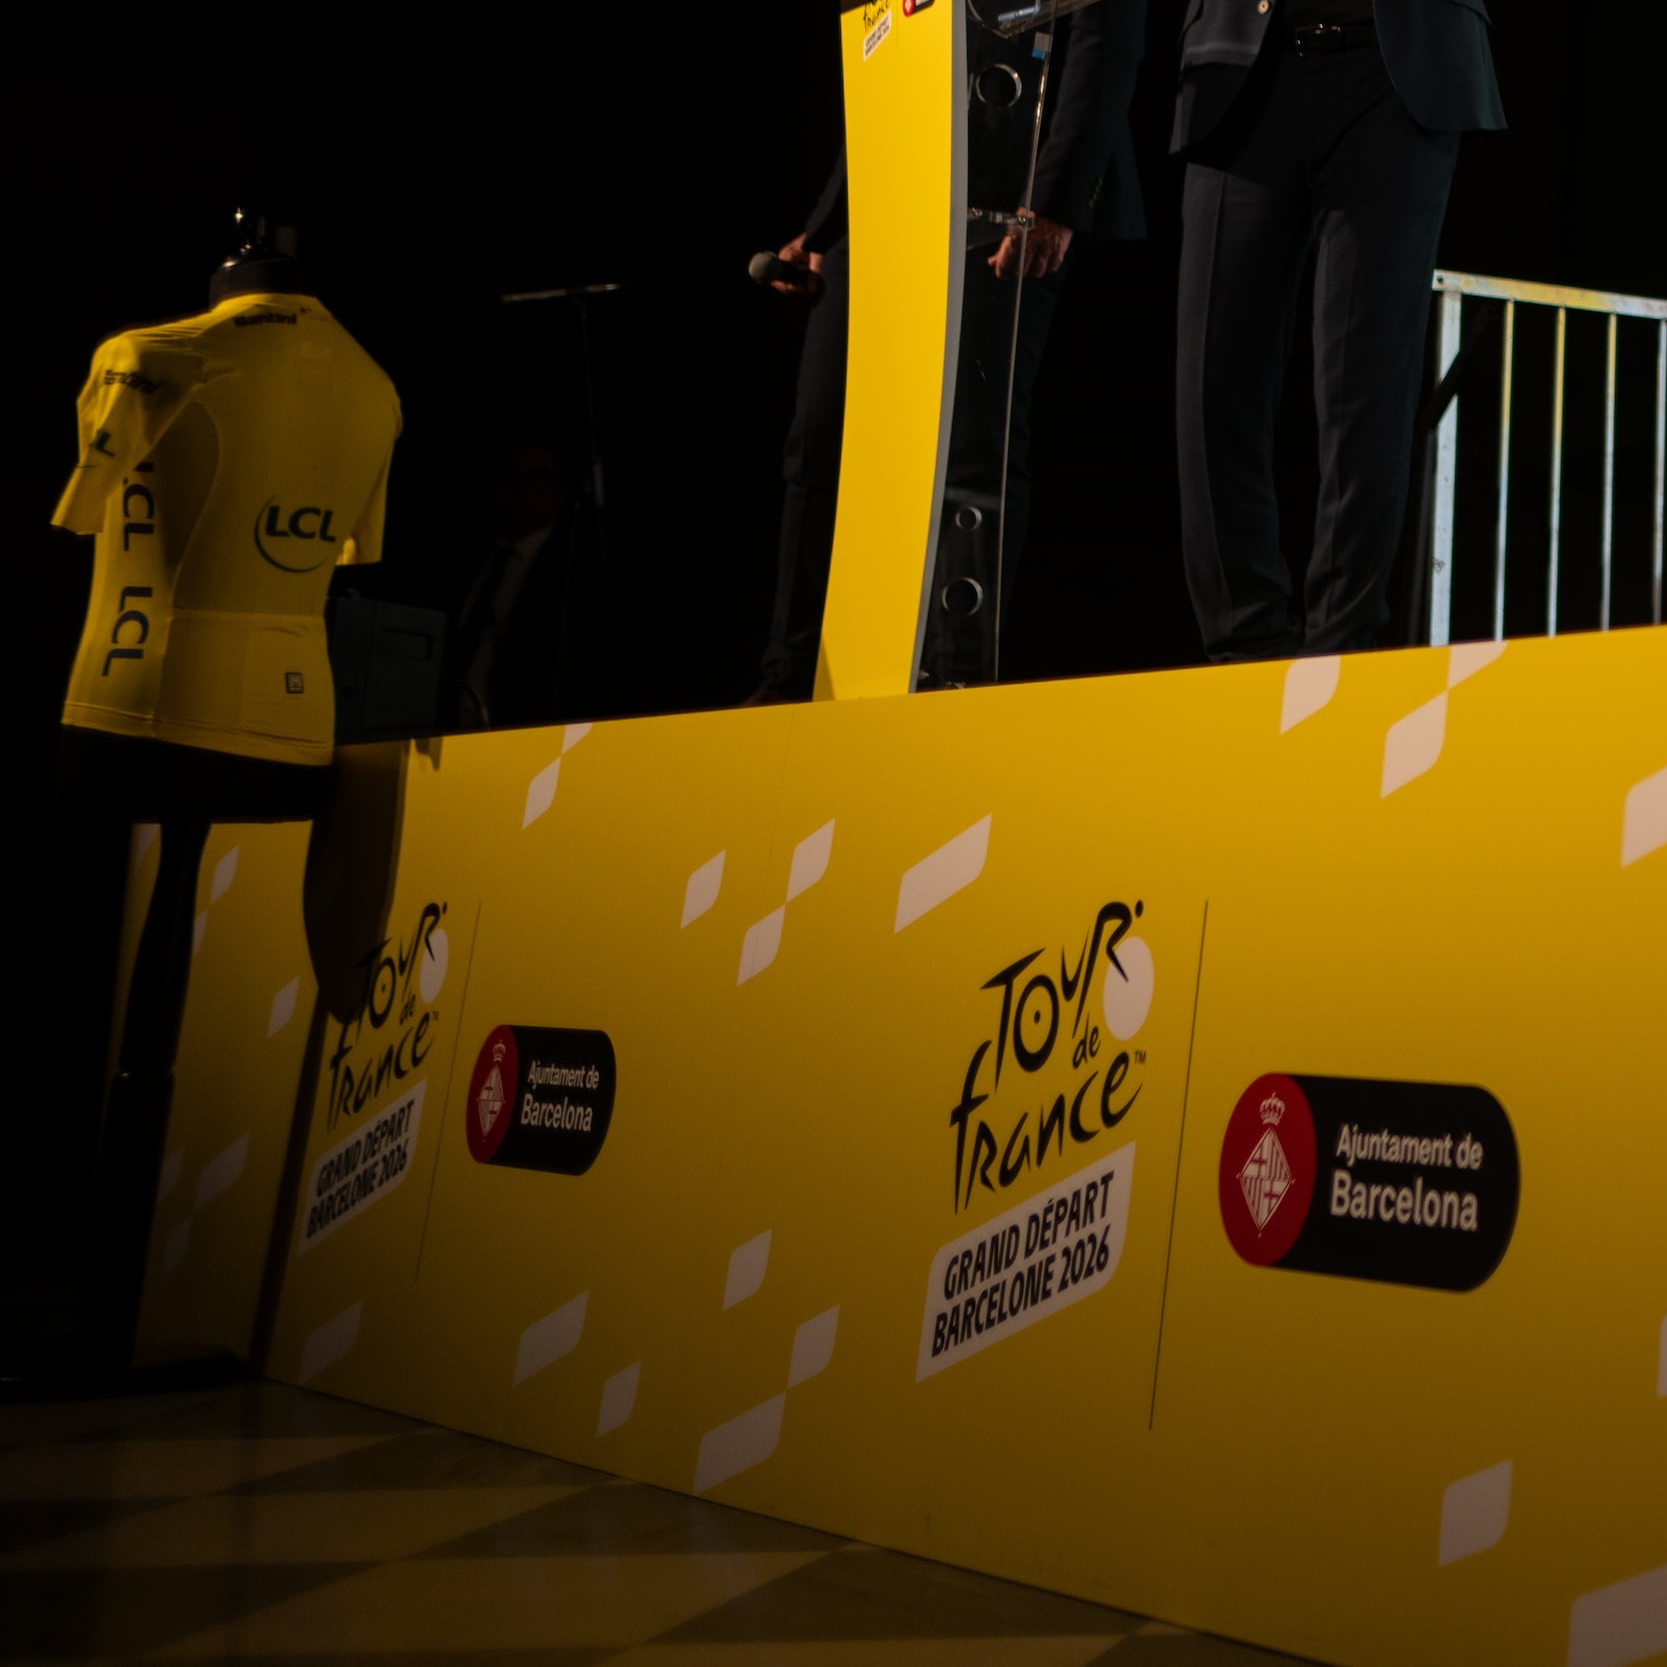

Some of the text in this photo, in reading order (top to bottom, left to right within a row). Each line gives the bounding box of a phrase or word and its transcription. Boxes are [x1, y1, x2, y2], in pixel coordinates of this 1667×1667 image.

[265, 505, 336, 542] LCL
[102, 586, 152, 676] LCL
[1072, 1012, 1099, 1069] de
[528, 1060, 599, 1089] Ajuntament de
[521, 1094, 593, 1132] Barcelona
[317, 1098, 415, 1197] GRAND DÉPART
[1336, 1124, 1483, 1169] Ajuntament de
[307, 1141, 408, 1239] BARCELONE 2026
[1331, 1171, 1479, 1232] Barcelona
[944, 1171, 1114, 1299] GRAND DÉPART
[932, 1227, 1110, 1358] BARCELONE 2026
